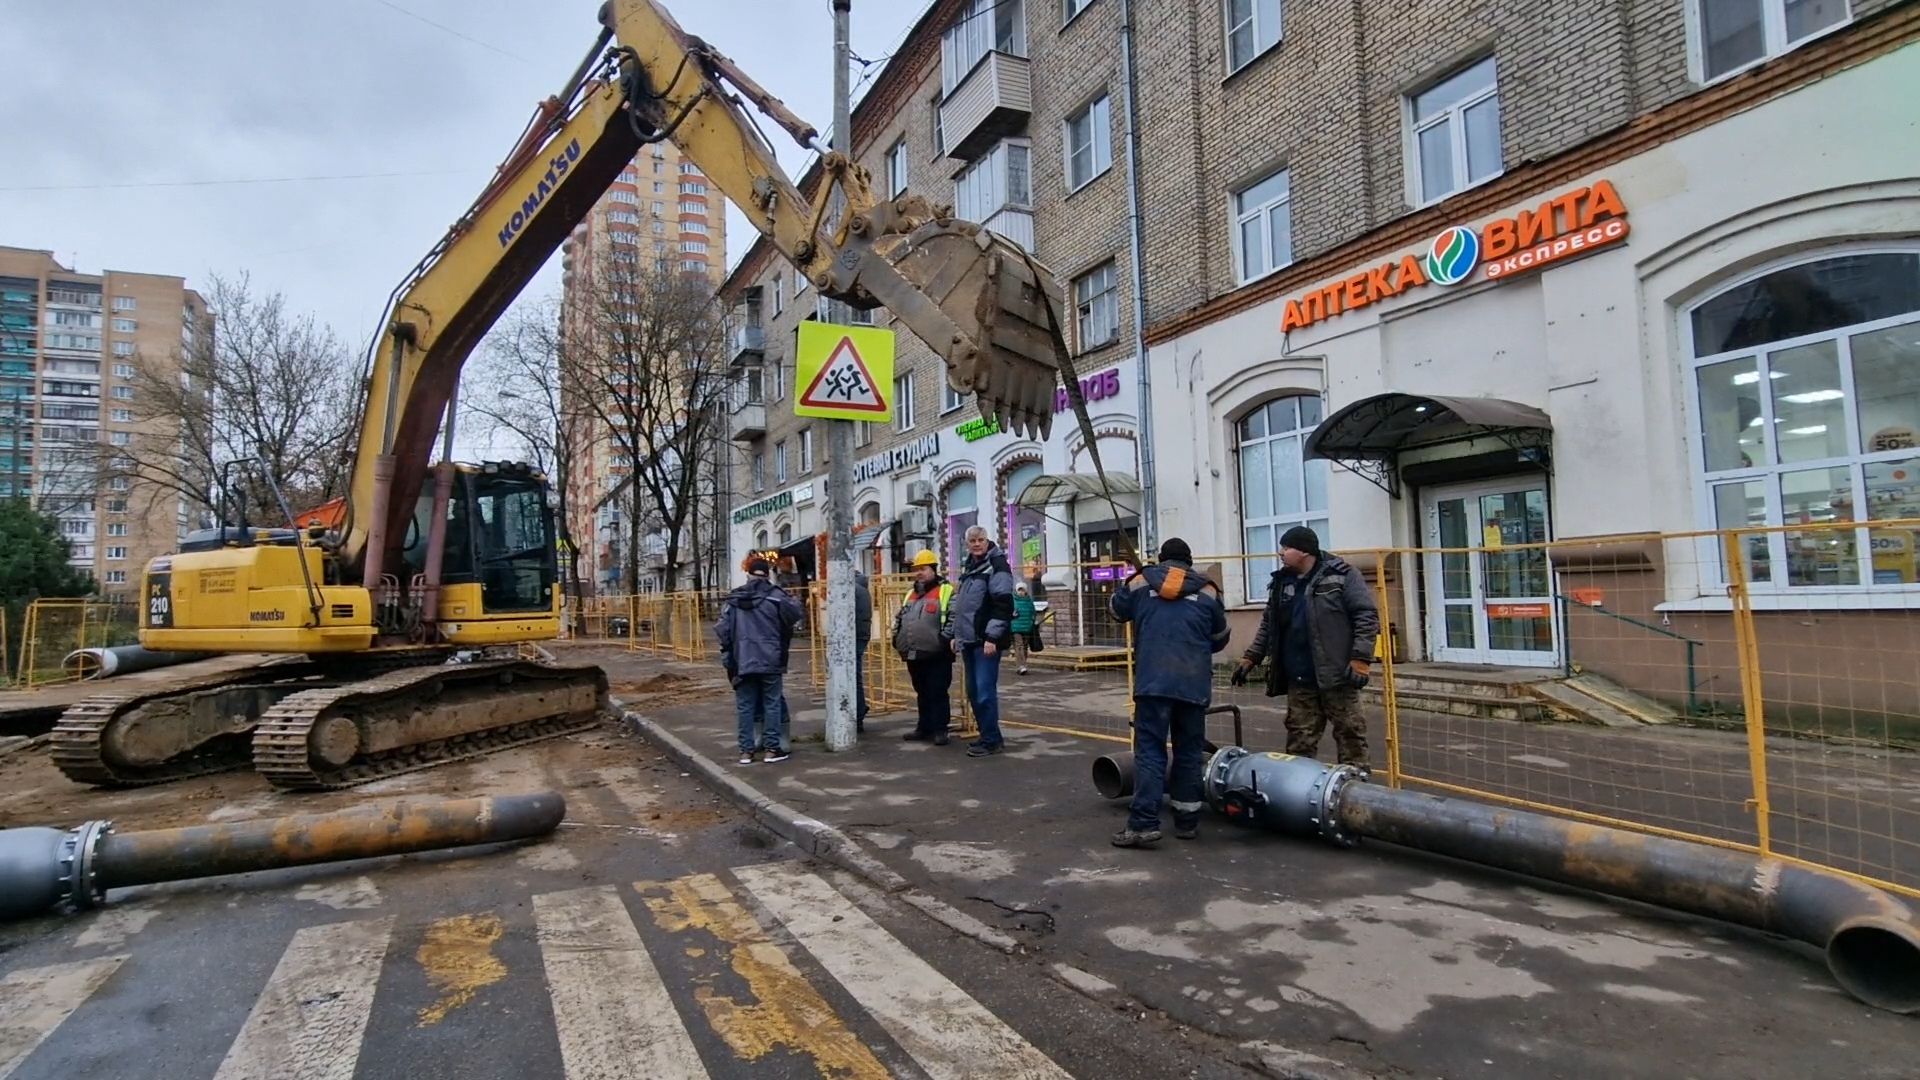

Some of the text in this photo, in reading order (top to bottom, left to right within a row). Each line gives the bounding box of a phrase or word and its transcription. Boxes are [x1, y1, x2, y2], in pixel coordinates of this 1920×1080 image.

[498, 138, 580, 248] KOMATSU
[1281, 179, 1628, 333] АПТЕКА ВИТА
[1487, 220, 1624, 279] ЭКСПРЕСС
[895, 432, 939, 470] СТУДИЯ
[1875, 438, 1915, 451] 50%
[151, 584, 161, 596] PC
[150, 597, 168, 614] 210
[250, 608, 285, 622] KOMATSU
